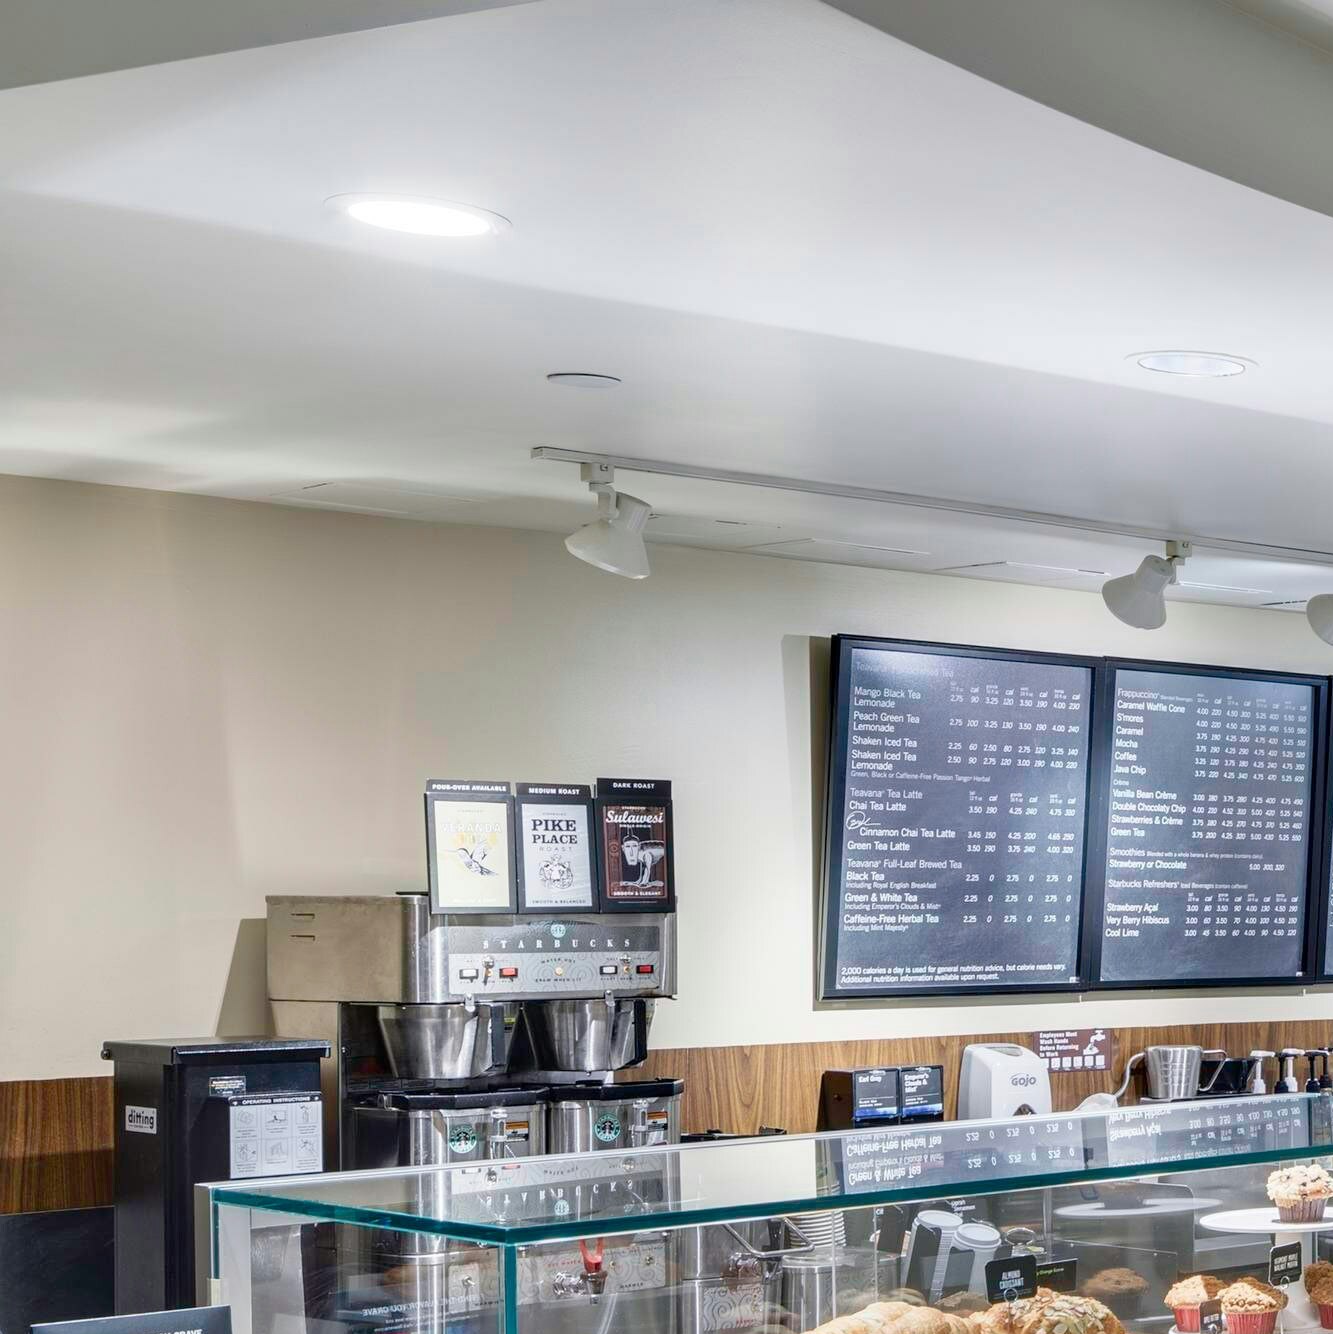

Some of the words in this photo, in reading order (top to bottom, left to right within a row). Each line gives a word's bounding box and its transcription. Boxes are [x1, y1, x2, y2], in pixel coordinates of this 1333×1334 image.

[854, 687, 881, 699] Mango
[883, 689, 905, 698] Black
[907, 691, 921, 699] Tea
[854, 698, 896, 708] Lemonade
[1117, 701, 1145, 711] Caramel
[1146, 702, 1167, 712] Waffle
[1168, 704, 1185, 713] Cone
[853, 712, 878, 722] Peach
[880, 713, 904, 722] Green
[905, 715, 920, 724] Tea
[853, 722, 895, 733] Lemonade
[852, 736, 883, 746] Shaken
[884, 738, 901, 747] Iced
[903, 739, 917, 748] Tea
[470, 784, 507, 792] AVAILABLE
[528, 787, 556, 795] MEDIUM
[849, 802, 868, 810] Chai
[869, 802, 884, 811] Tea
[886, 803, 906, 812] Latte
[605, 810, 665, 824] Sulawesi
[531, 819, 577, 832] PIKE
[859, 827, 899, 837] Cinnamon
[901, 828, 919, 838] Chai
[920, 829, 934, 838] Tea
[936, 830, 956, 838] Latte
[532, 835, 578, 844] PLACE
[848, 841, 872, 851] Green
[873, 842, 888, 851] Tea
[890, 842, 910, 851] Latte
[847, 872, 869, 881] Black
[870, 872, 885, 881] Tea
[845, 893, 869, 902] Green
[871, 894, 878, 902] &
[879, 894, 903, 902] White
[904, 894, 918, 902] Tea
[844, 914, 897, 924] Caffeine-Free
[898, 914, 924, 924] Herbal
[926, 915, 939, 923] Tea
[483, 939, 630, 949] STARBUCKS
[1011, 1076, 1037, 1087] GOJO
[128, 1111, 154, 1129] ditting
